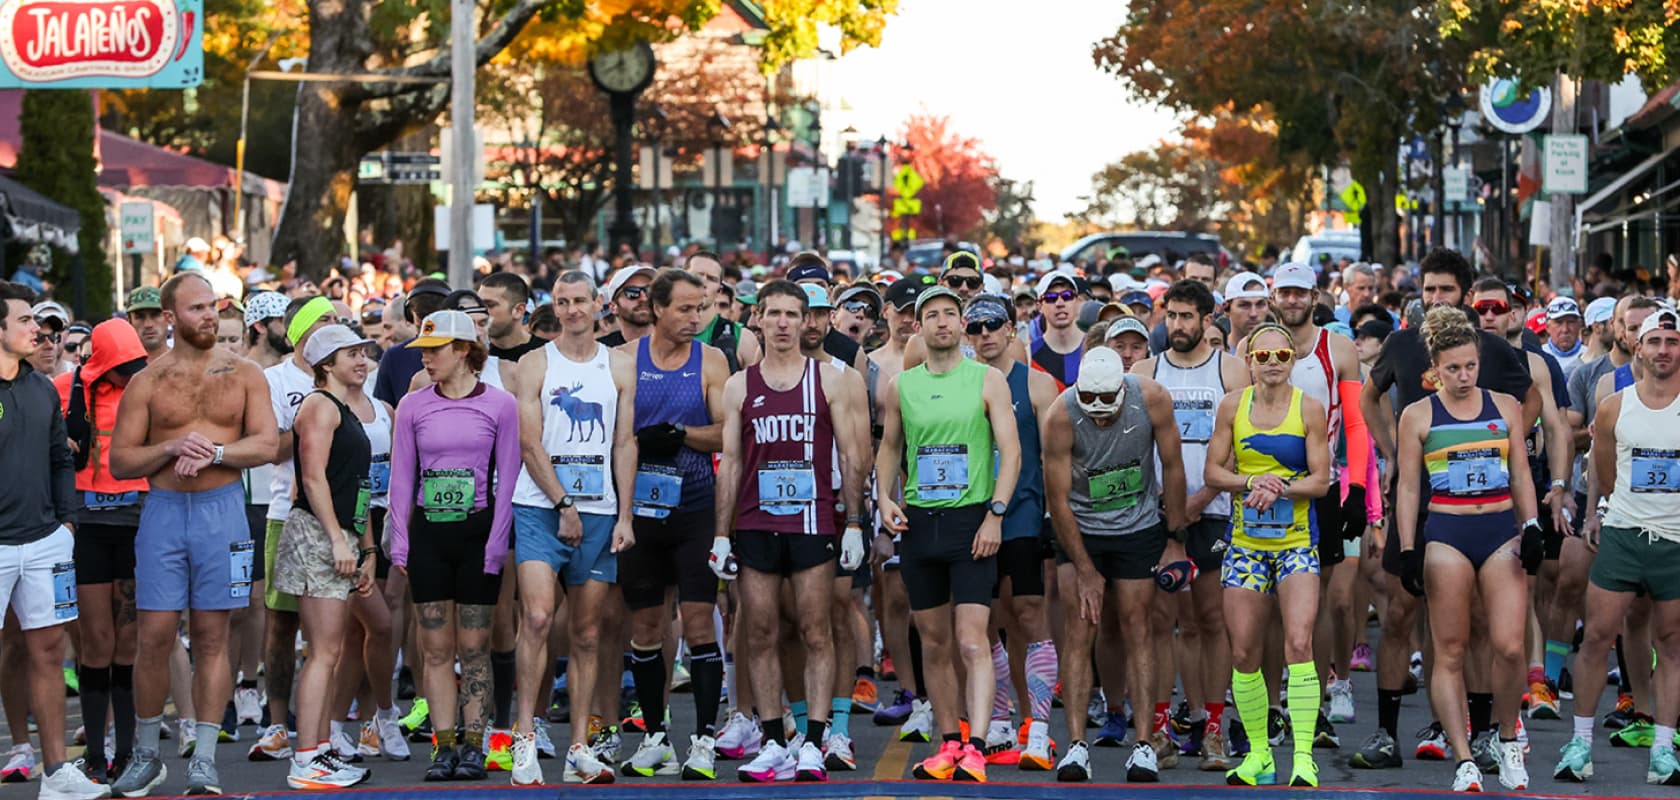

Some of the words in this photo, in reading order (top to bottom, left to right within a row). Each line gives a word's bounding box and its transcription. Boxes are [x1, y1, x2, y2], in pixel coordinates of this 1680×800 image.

[27, 5, 151, 61] JALAPEÑOS
[125, 215, 147, 224] PAY
[752, 413, 816, 444] NOTCH
[1182, 422, 1192, 435] 7
[936, 468, 946, 482] 3
[1466, 472, 1487, 487] F4
[1647, 471, 1667, 485] 32
[572, 478, 583, 492] 4
[776, 483, 797, 498] 10
[1107, 482, 1127, 495] 24
[433, 491, 465, 505] 492
[650, 487, 660, 501] 8
